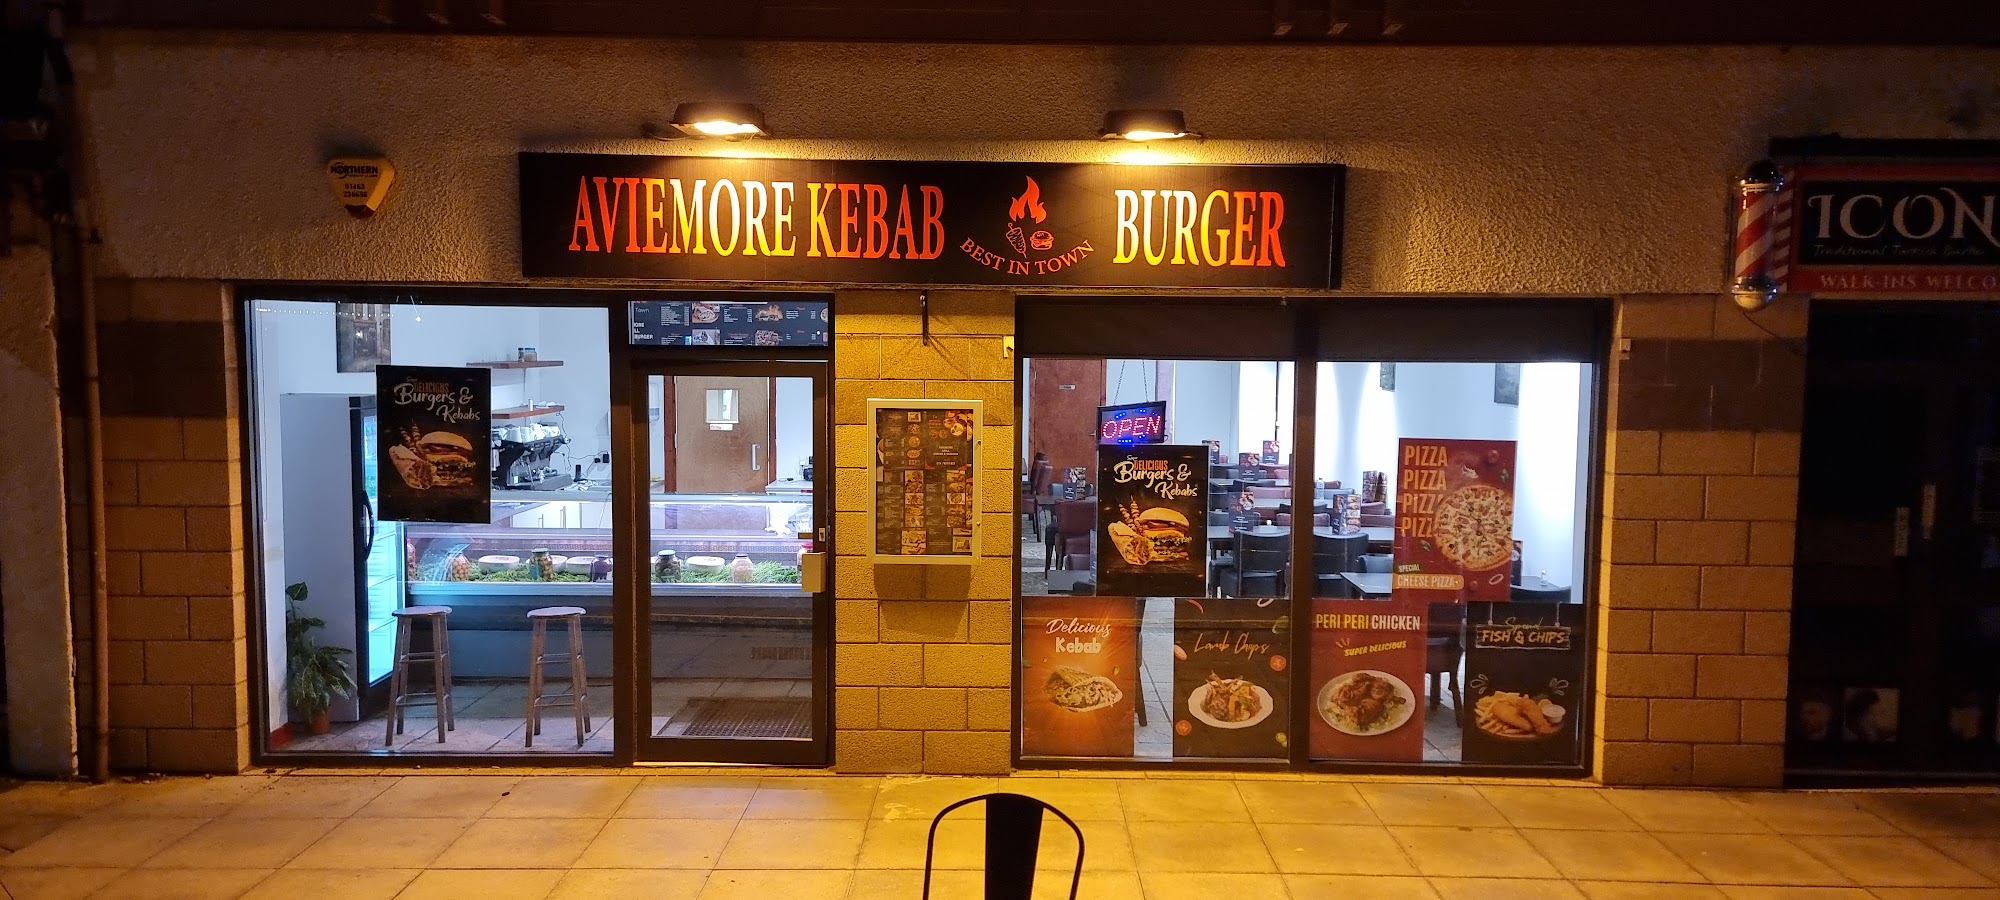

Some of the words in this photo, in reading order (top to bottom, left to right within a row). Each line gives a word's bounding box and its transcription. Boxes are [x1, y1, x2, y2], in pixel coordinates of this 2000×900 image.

[330, 165, 378, 174] NORTHERN
[568, 175, 797, 258] AVIEMORE
[806, 181, 946, 260] KEBAB
[1112, 189, 1287, 268] BURGER
[959, 237, 1006, 271] BEST
[1007, 260, 1030, 276] IN
[1034, 239, 1096, 276] TOWN
[1820, 274, 1917, 289] WALK-INS
[393, 383, 455, 411] Burgers
[458, 386, 474, 405] &
[414, 382, 449, 393] DELICIOUS
[436, 404, 481, 424] Kebabs
[1102, 415, 1161, 439] OPEN
[1133, 459, 1169, 471] DELICIOUS
[1404, 445, 1449, 467] PIZZA
[1113, 460, 1175, 489] Burgers
[1176, 463, 1192, 482] &
[1403, 469, 1447, 490] PIZZA
[1154, 481, 1198, 500] Kebabs
[1400, 517, 1435, 538] PIZZ
[1398, 564, 1421, 572] SPECIAL
[1397, 574, 1430, 587] CHEESE
[1431, 575, 1455, 587] PIZZA
[1045, 617, 1111, 638] Delicious
[1315, 613, 1341, 629] PERI
[1344, 614, 1369, 630] PERI
[1371, 614, 1421, 631] CHICKEN
[1055, 636, 1102, 654] Kebab
[1193, 630, 1230, 653] Lamb
[1234, 631, 1270, 661] Chops
[1481, 629, 1512, 643] FISH
[1514, 630, 1525, 645] &
[1528, 631, 1566, 644] CHIPS
[1344, 646, 1368, 657] SUPER
[1369, 640, 1407, 653] DELICIOUS
